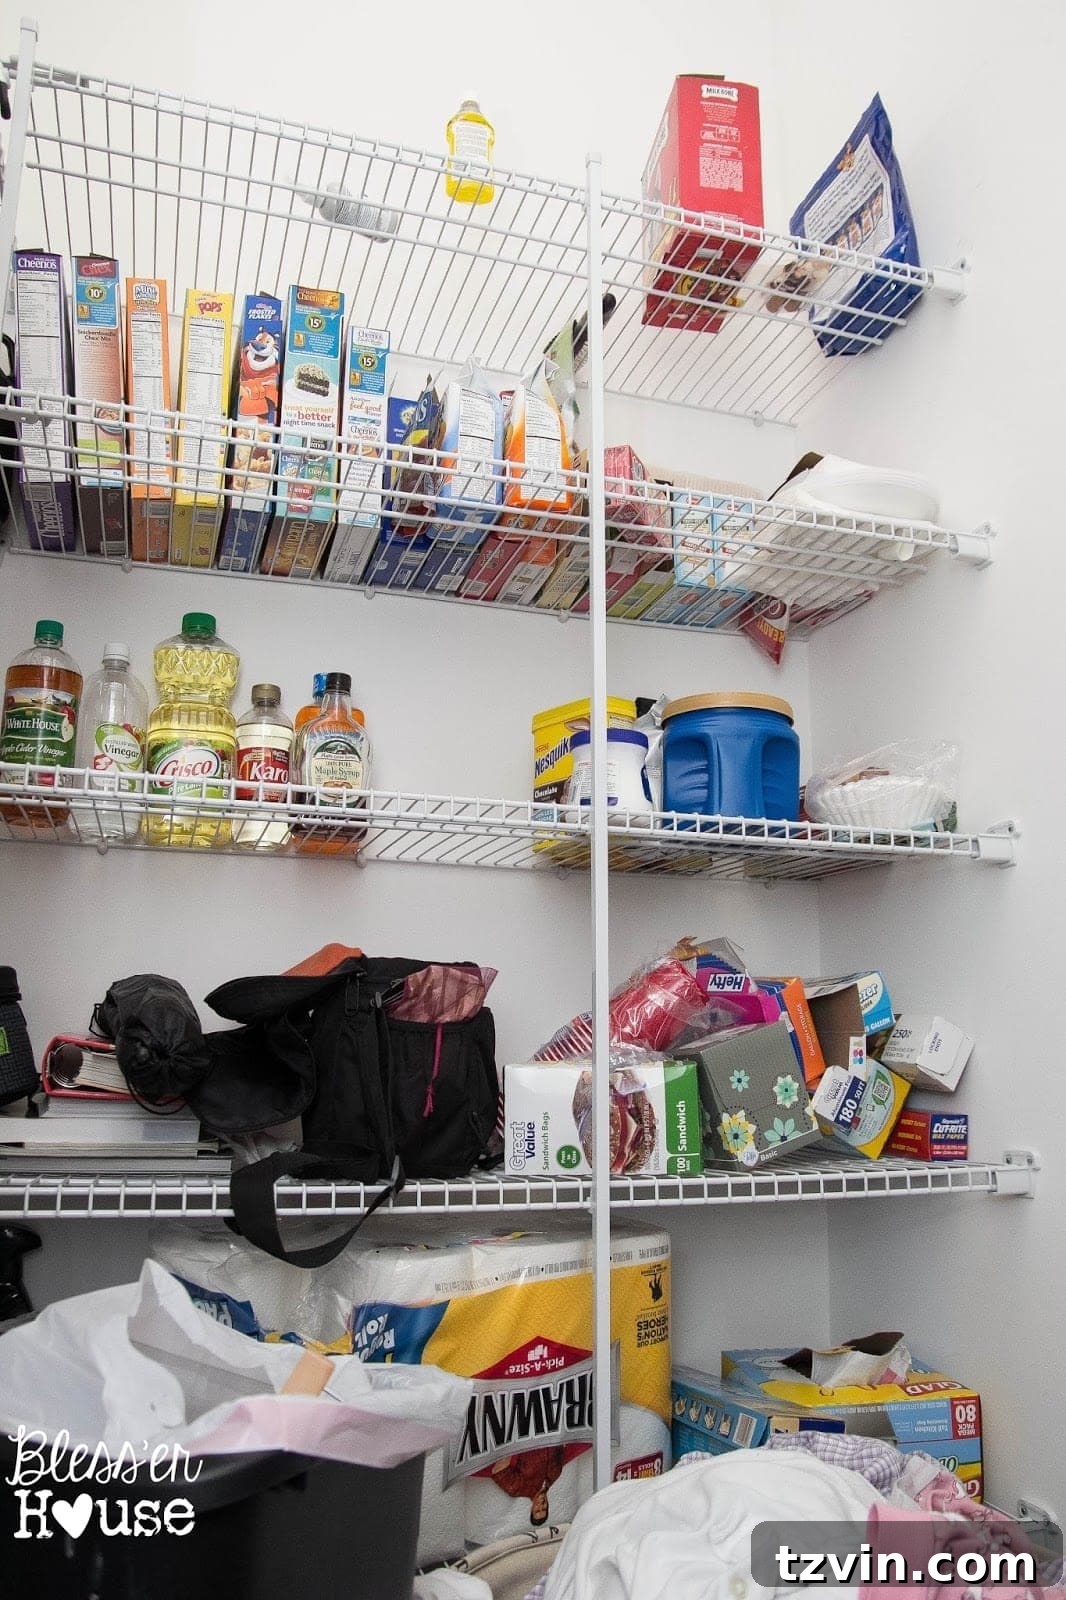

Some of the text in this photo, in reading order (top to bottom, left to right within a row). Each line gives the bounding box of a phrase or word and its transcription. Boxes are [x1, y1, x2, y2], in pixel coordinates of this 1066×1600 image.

[17, 257, 57, 270] Cheerios
[198, 302, 223, 314] POPS
[297, 410, 332, 421] better
[283, 419, 300, 428] night
[317, 421, 336, 429] snack
[7, 717, 60, 731] WHITE HOUSE
[104, 743, 140, 758] Vinegar
[534, 735, 570, 779] Nesquik
[159, 759, 213, 787] Crisco
[250, 760, 289, 784] Karo
[315, 766, 361, 779] Maple Syrup
[534, 786, 558, 799] Chocolate
[710, 974, 745, 991] Hefty
[838, 1099, 858, 1123] 180
[676, 1100, 687, 1152] Sandwich
[508, 1121, 527, 1171] Great
[525, 1121, 536, 1159] Value
[541, 1111, 550, 1171] Sandwich Bags
[759, 1149, 778, 1162] Basic
[677, 1157, 687, 1174] 100
[905, 1381, 962, 1396] GLAD
[456, 1370, 593, 1465] RAWNY
[955, 1403, 977, 1424] 80
[914, 1425, 937, 1433] Kitchen
[957, 1422, 975, 1430] PACK
[957, 1428, 976, 1436] MEGA
